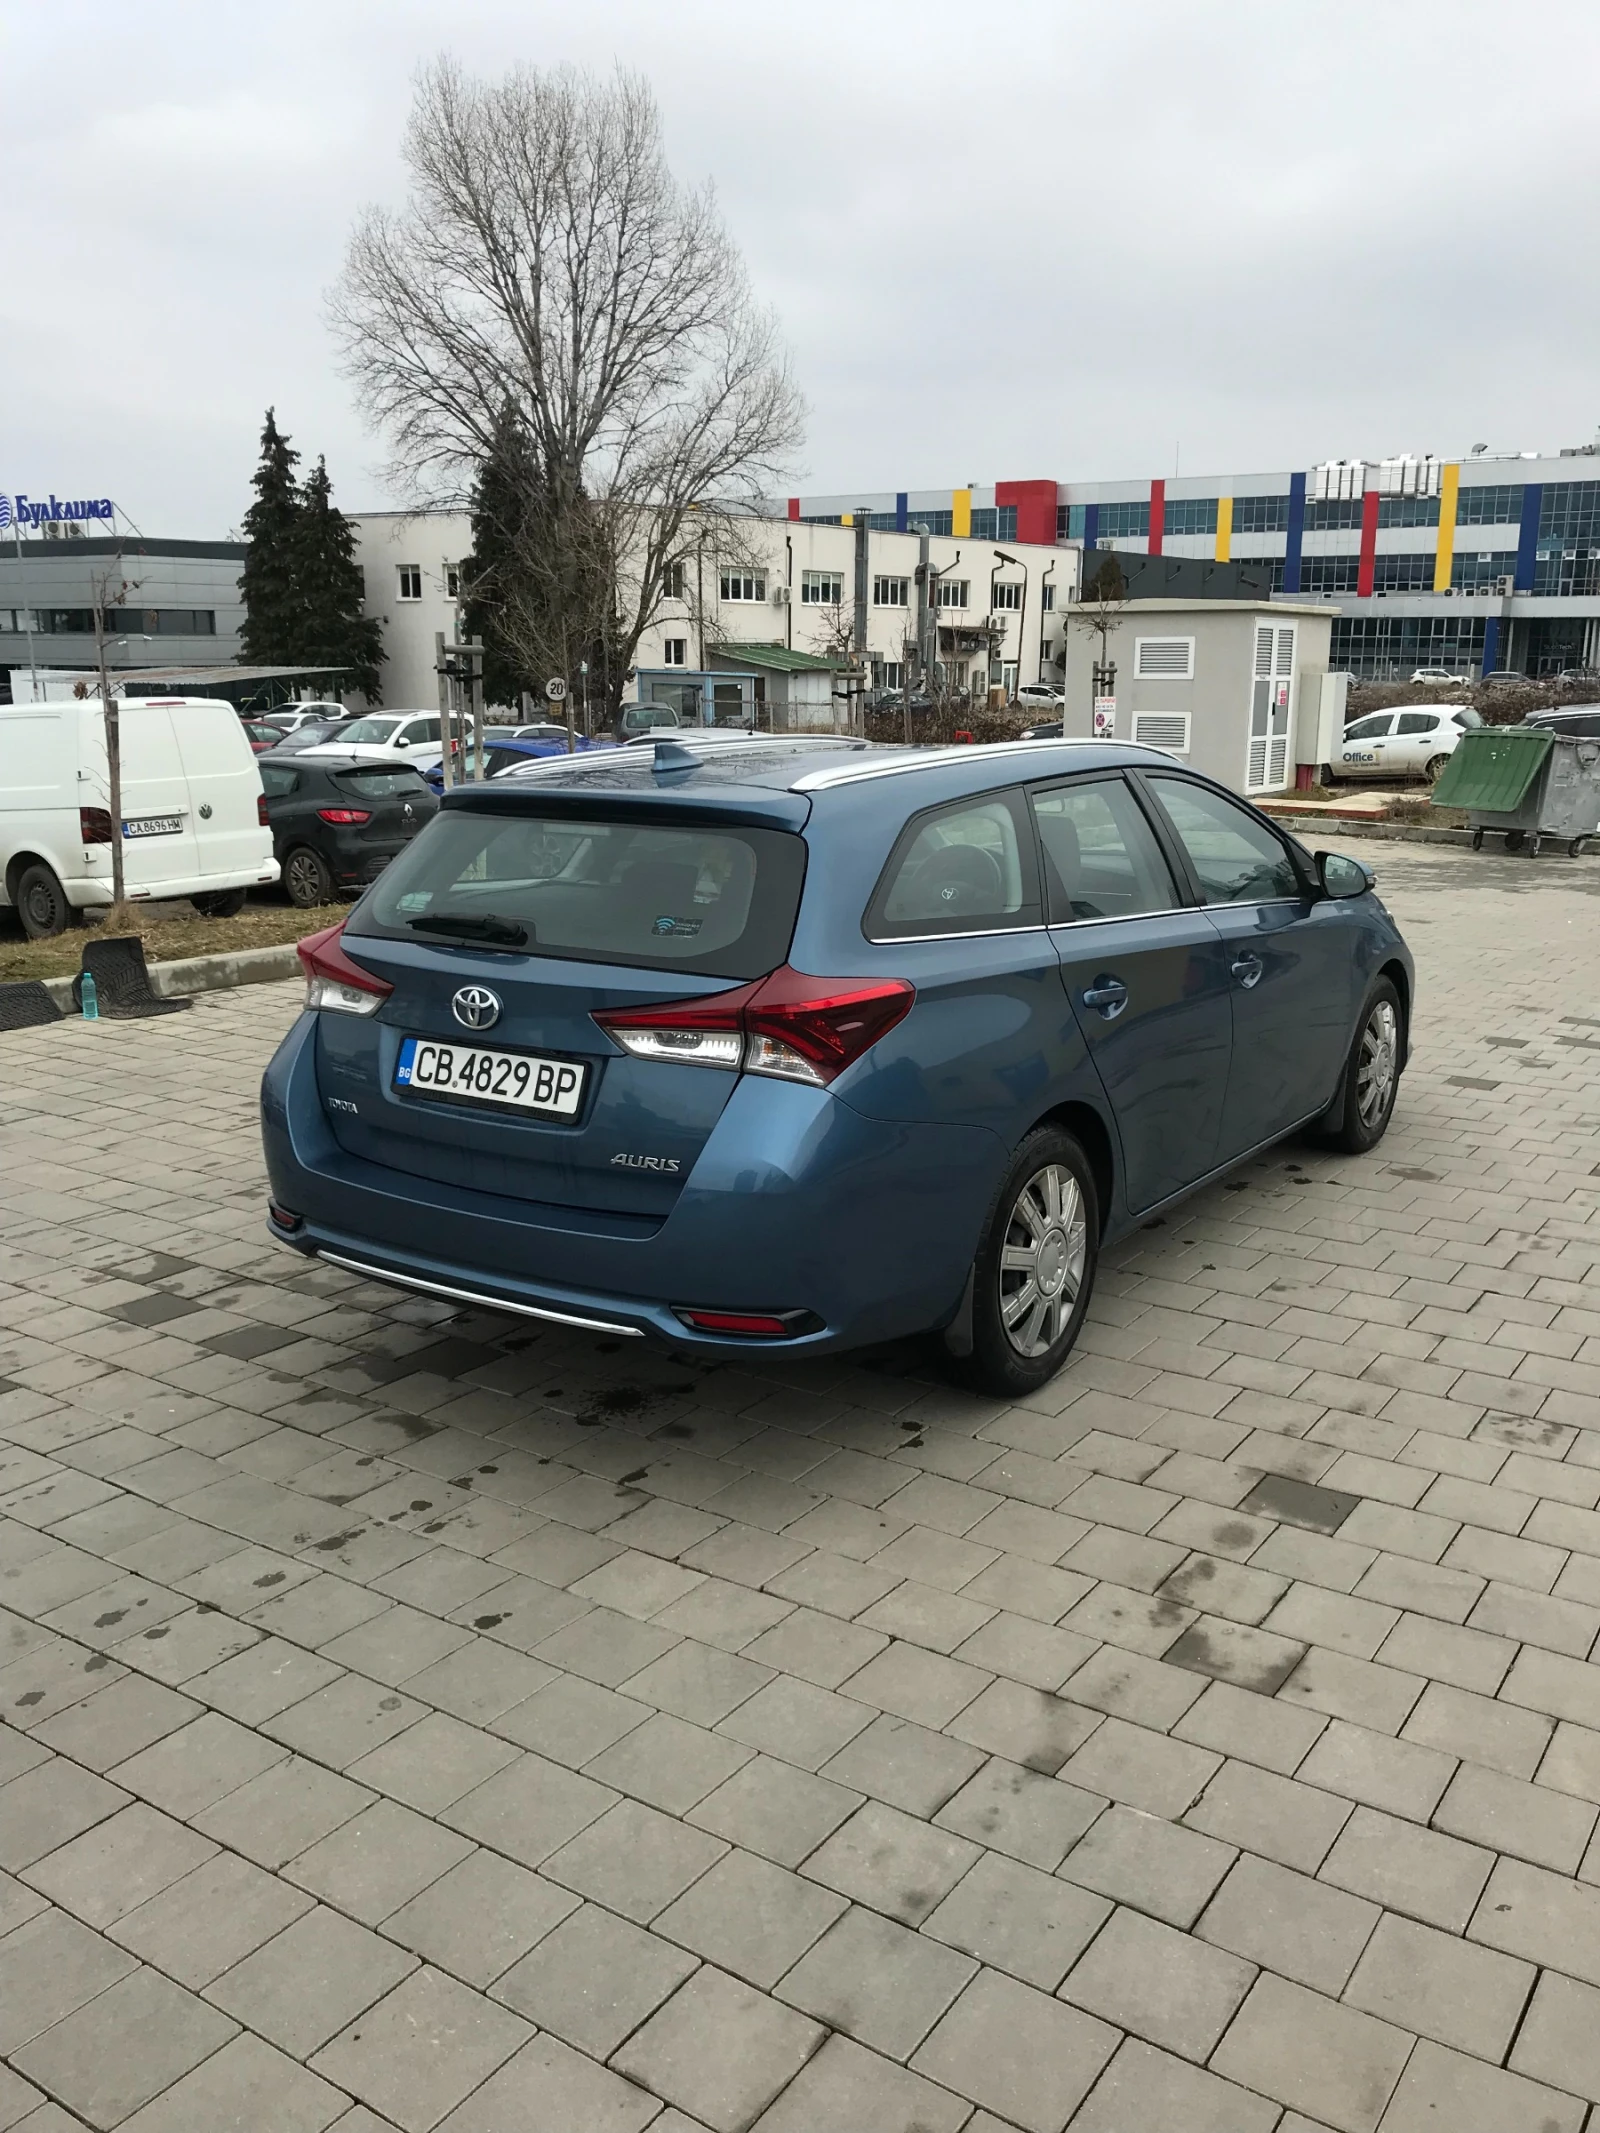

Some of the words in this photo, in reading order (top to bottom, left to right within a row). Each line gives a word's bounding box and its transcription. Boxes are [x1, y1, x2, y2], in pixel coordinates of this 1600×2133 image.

[15, 494, 113, 529] Булклима
[550, 682, 563, 695] 20
[1342, 752, 1374, 762] Office
[398, 1066, 411, 1079] BG
[459, 1053, 530, 1098] 4829
[328, 1097, 358, 1114] TOYOTA
[609, 1153, 680, 1172] AURIS
